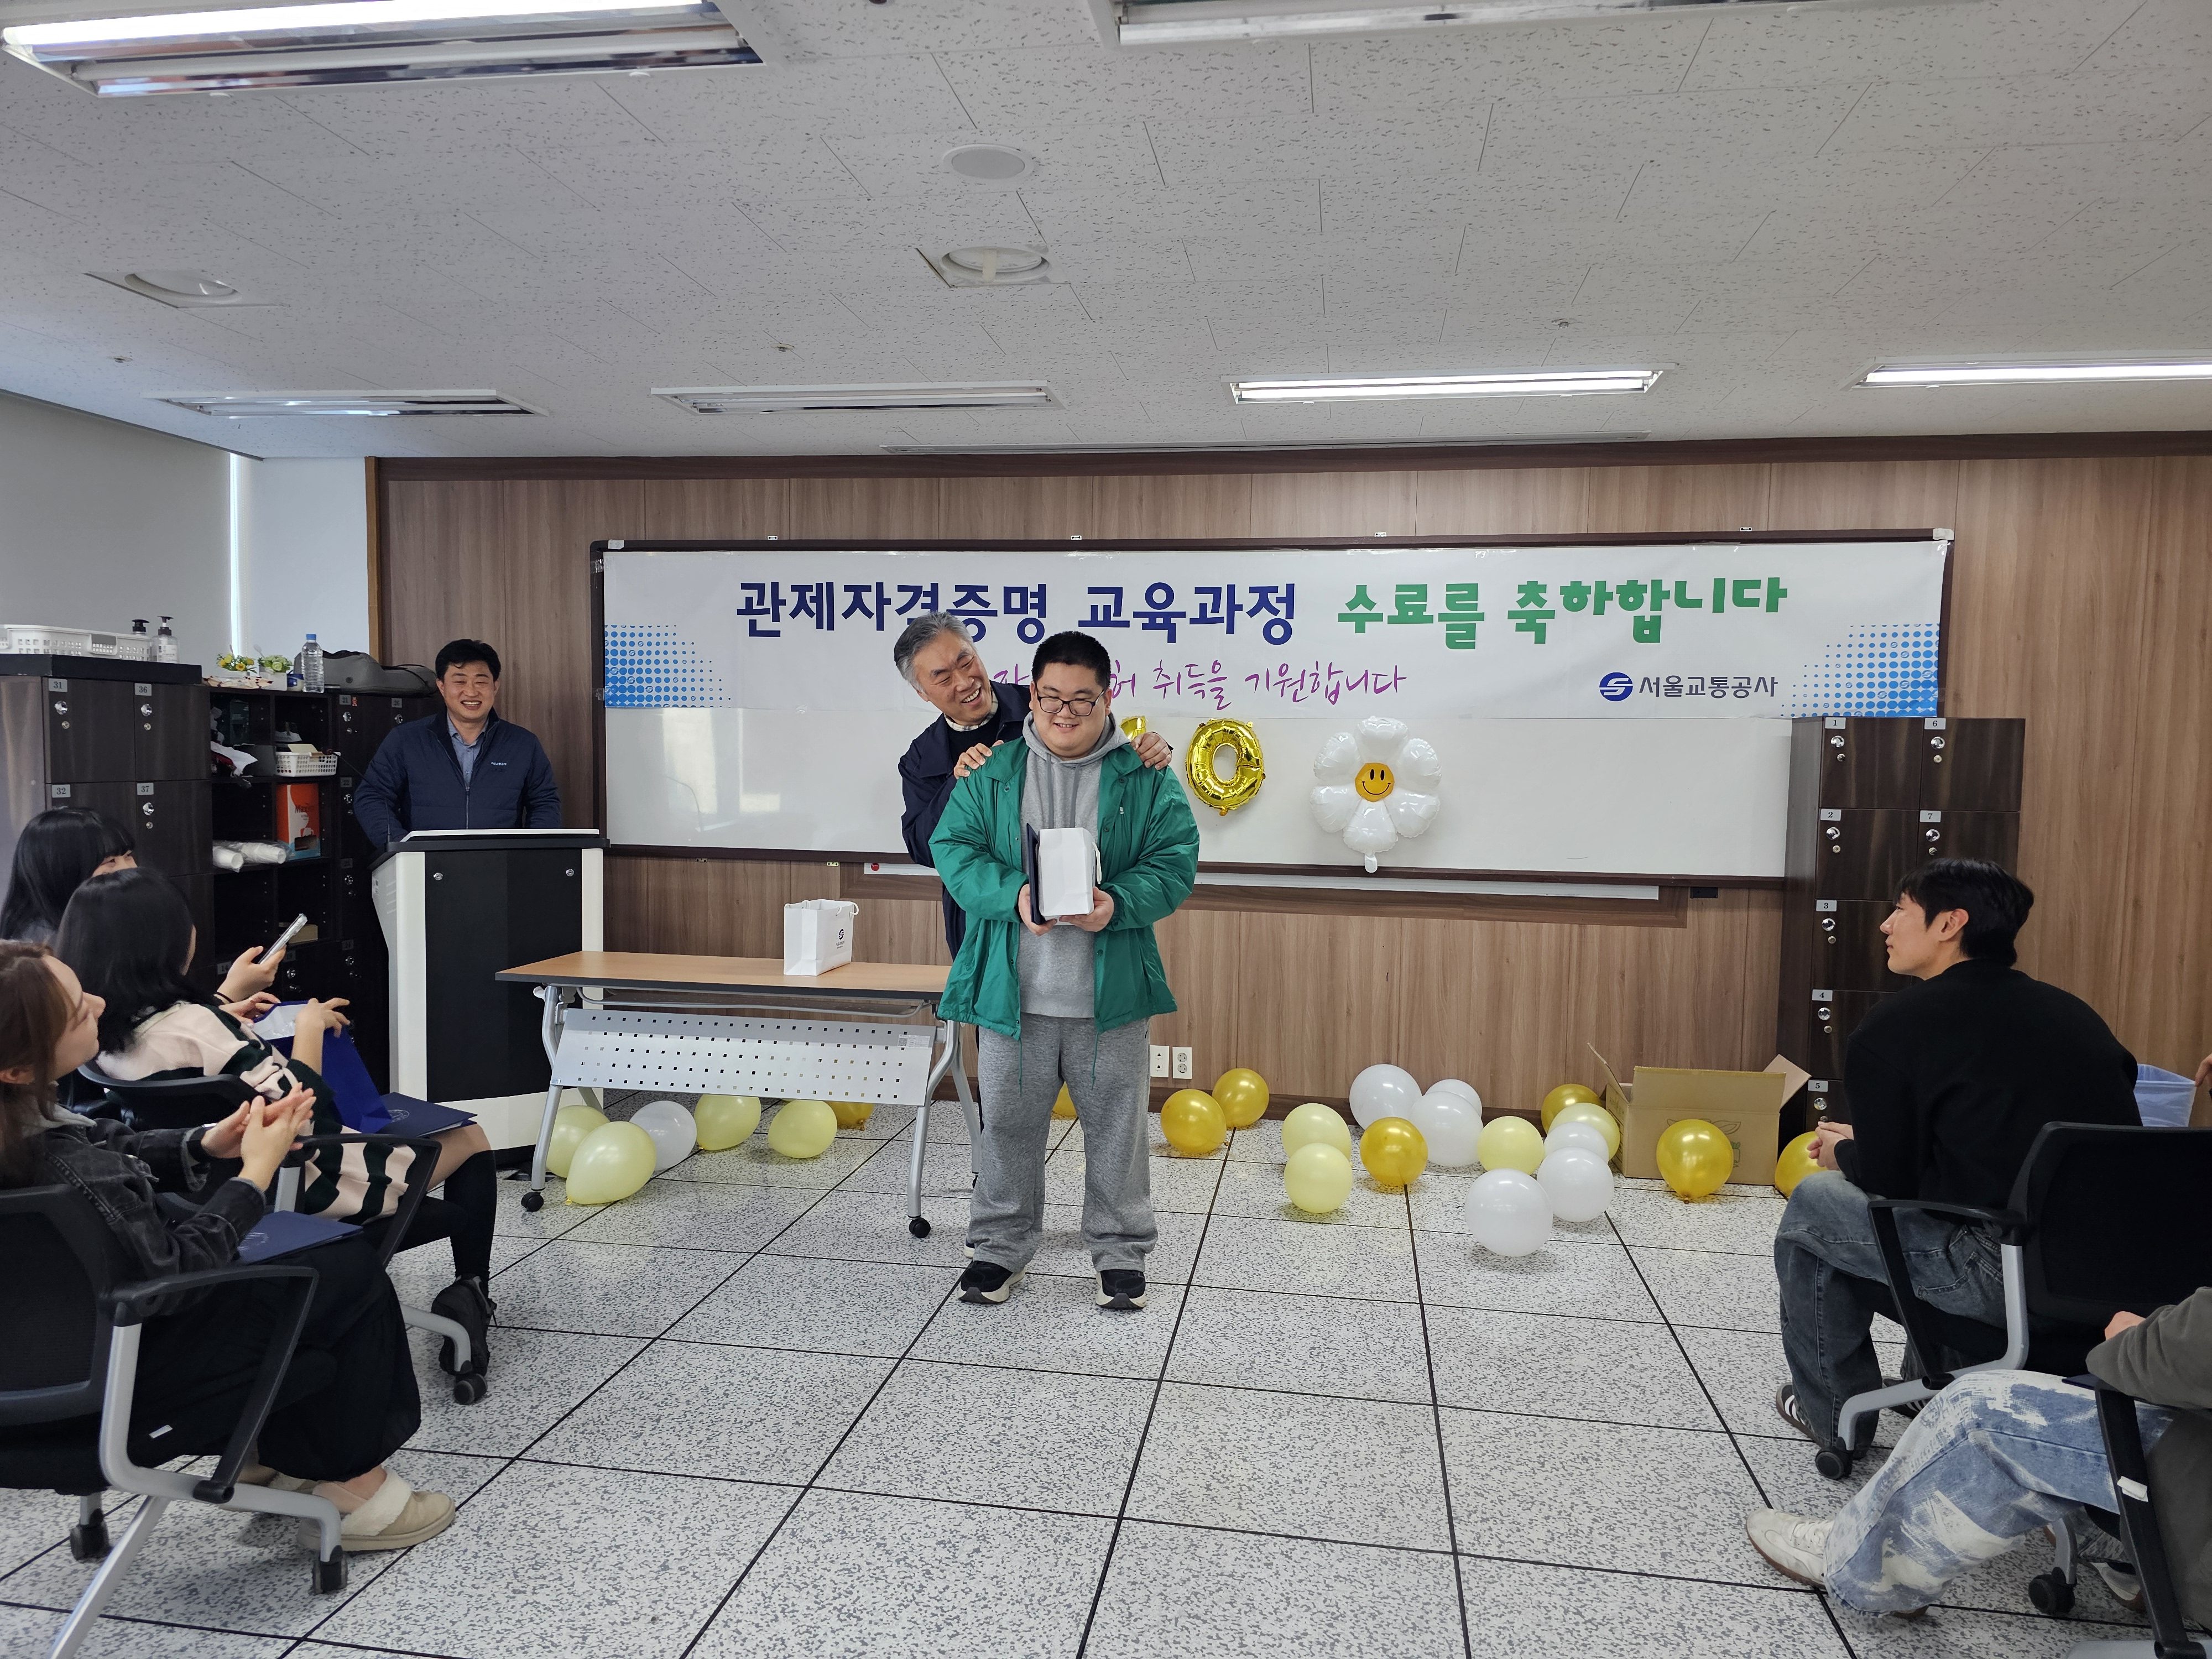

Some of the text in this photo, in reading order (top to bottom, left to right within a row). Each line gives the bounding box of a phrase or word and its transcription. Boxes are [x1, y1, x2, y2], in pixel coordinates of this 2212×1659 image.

[737, 578, 1787, 650] 관제자격증명 교육과정 수료를 축하합니다
[1154, 660, 1232, 711] 취득을
[1244, 661, 1407, 706] 기원합니다
[1639, 675, 1778, 700] 서울교통공사
